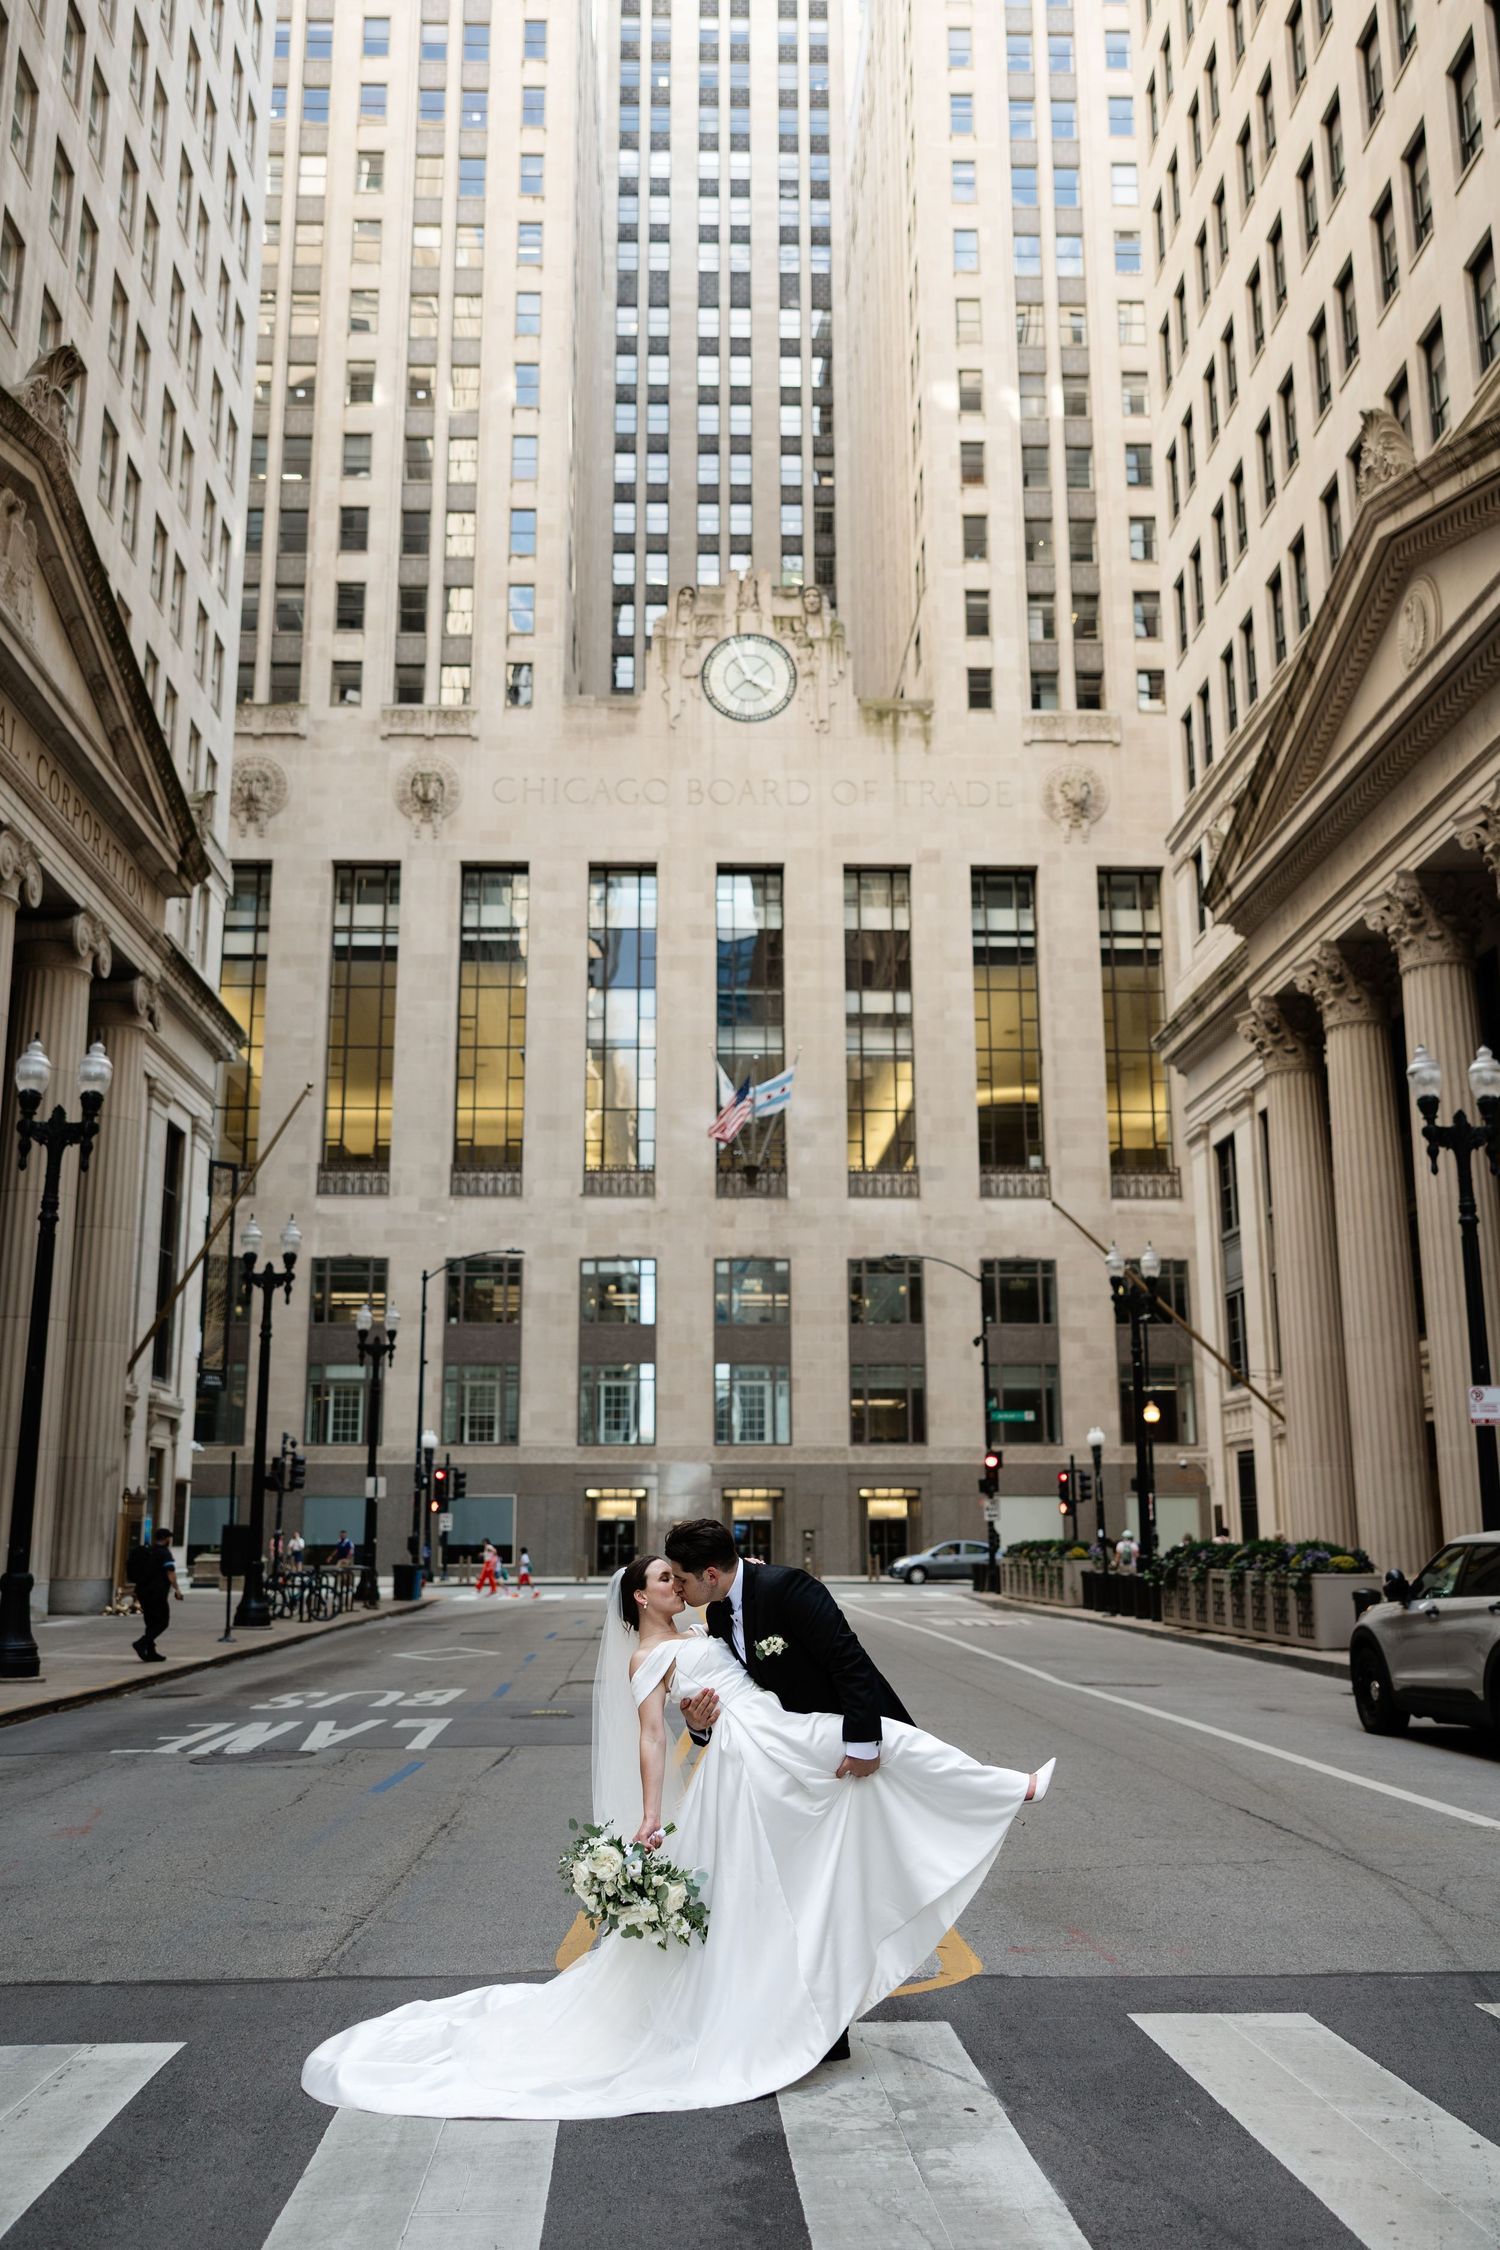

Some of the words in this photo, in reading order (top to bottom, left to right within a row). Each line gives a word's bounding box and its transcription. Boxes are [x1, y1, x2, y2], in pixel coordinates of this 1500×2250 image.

[492, 776, 670, 807] CHICAGO
[687, 777, 811, 808] BOARD
[831, 778, 878, 808] OF
[895, 778, 1014, 809] TRADE
[36, 754, 147, 907] CORPORATION
[249, 1688, 468, 1710] BUS
[110, 1718, 453, 1754] LANE
